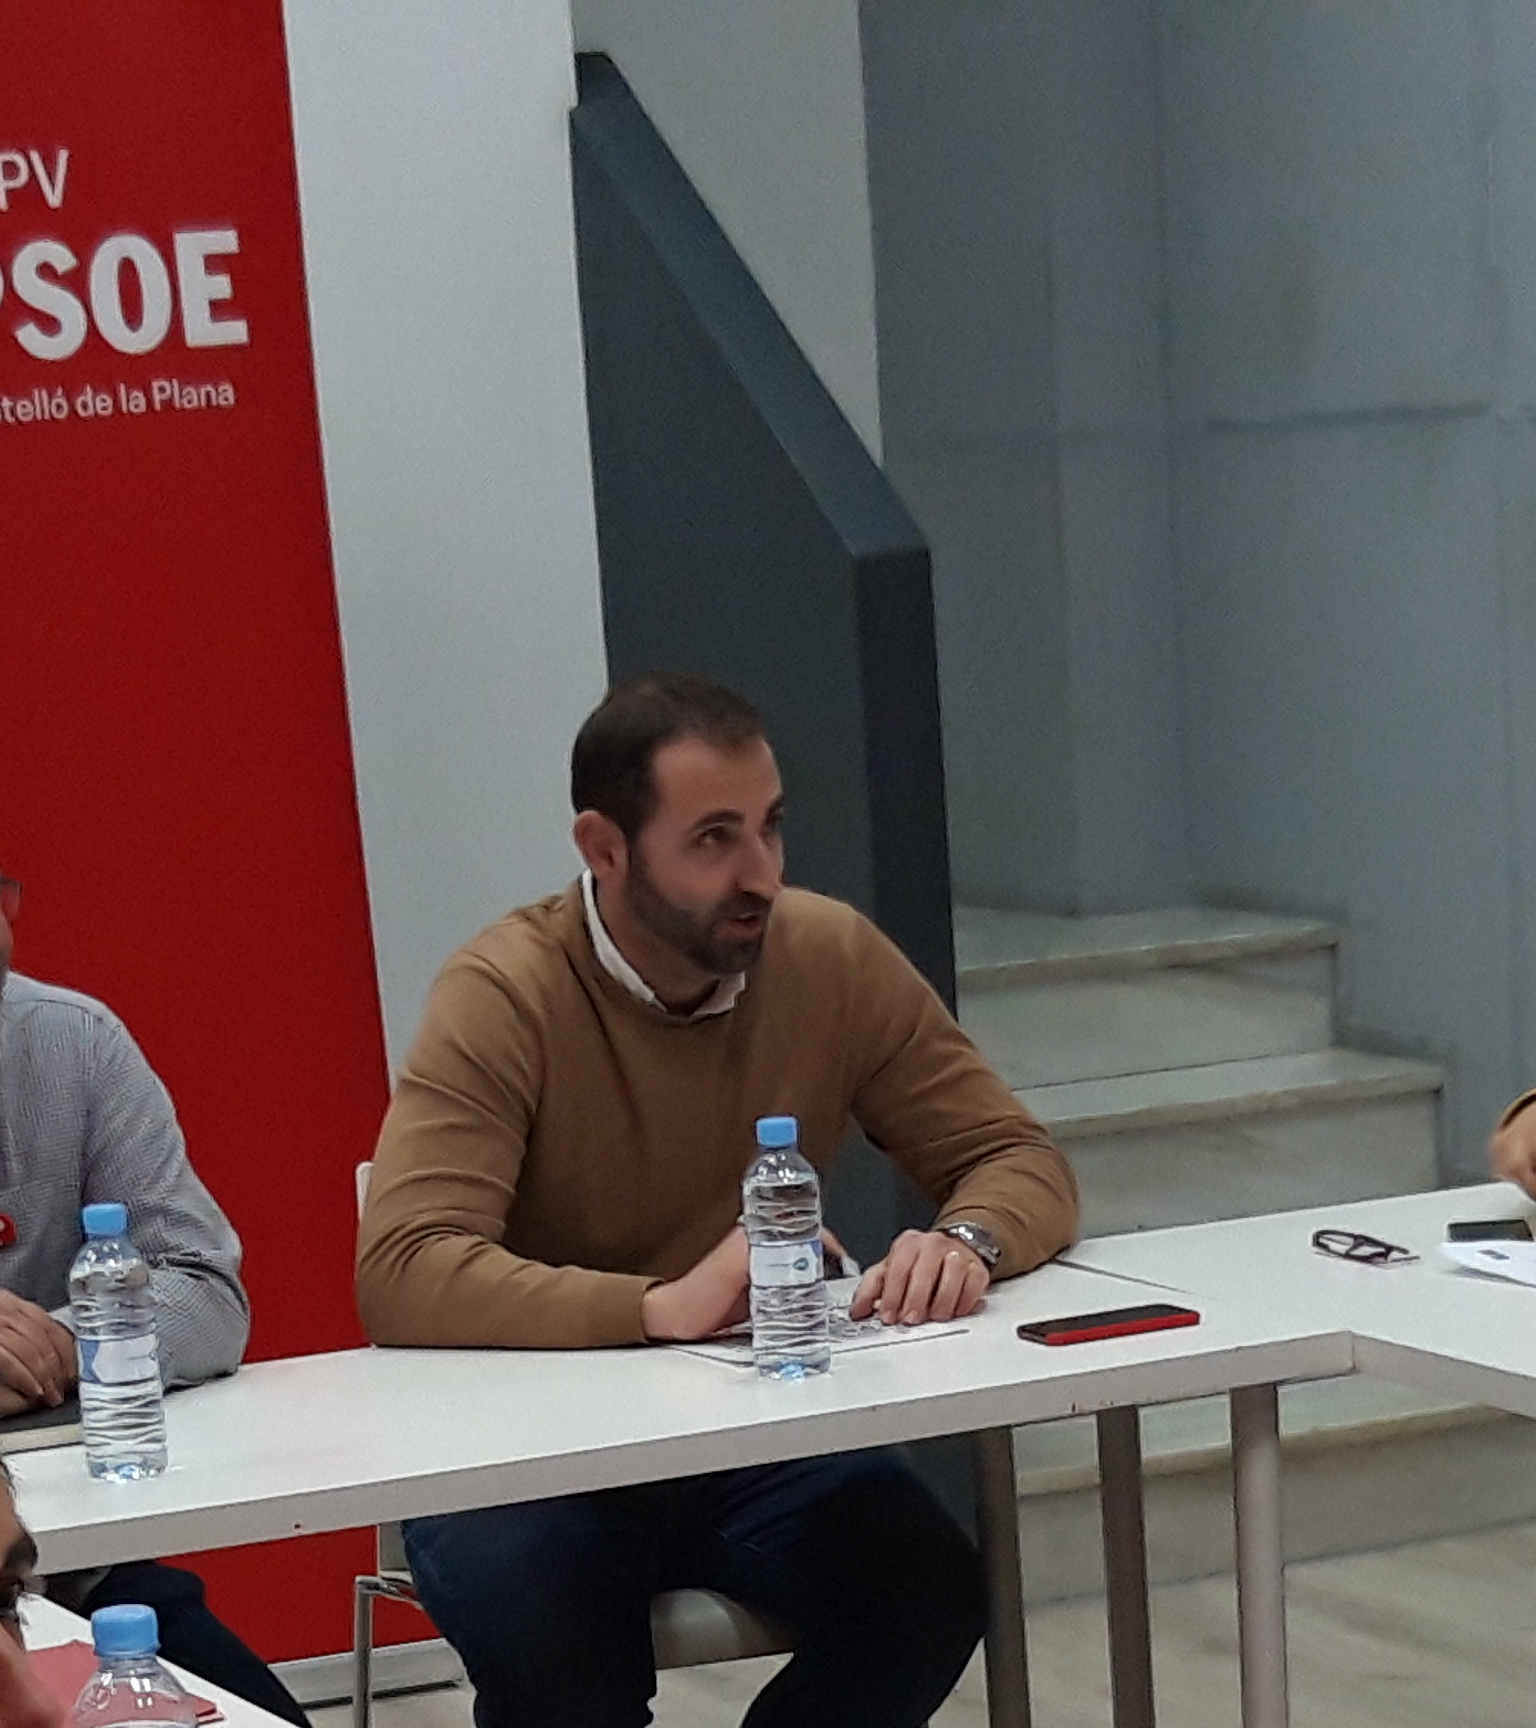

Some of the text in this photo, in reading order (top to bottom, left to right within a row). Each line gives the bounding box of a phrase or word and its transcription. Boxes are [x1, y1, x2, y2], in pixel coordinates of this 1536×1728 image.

[76, 384, 114, 418] de
[119, 382, 147, 414] la
[151, 377, 236, 411] Plana
